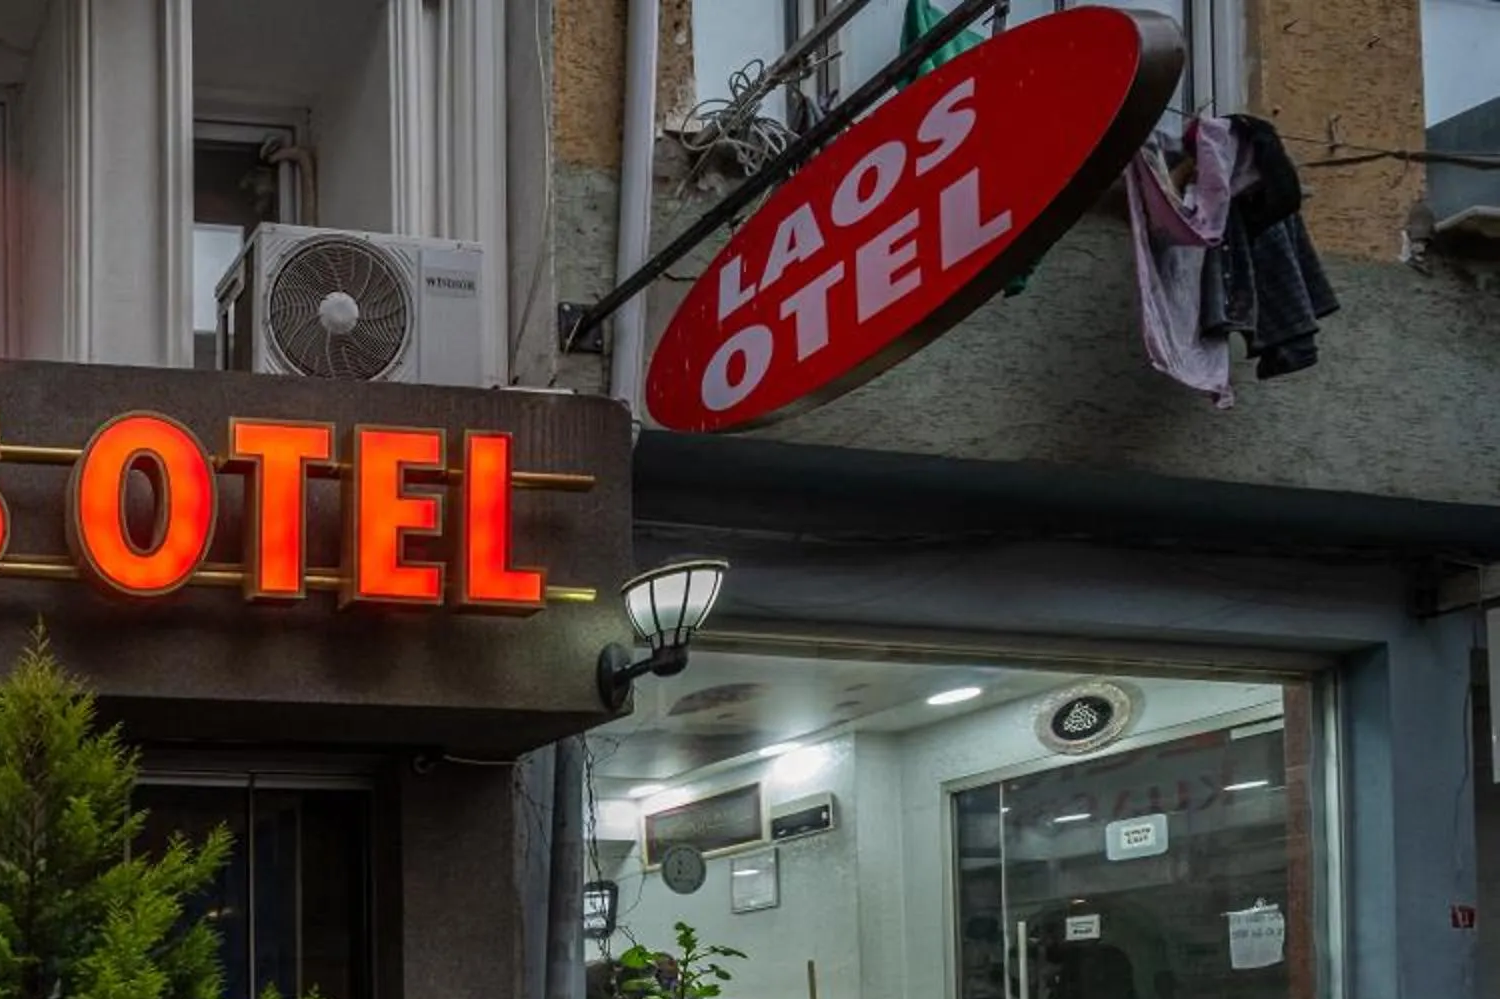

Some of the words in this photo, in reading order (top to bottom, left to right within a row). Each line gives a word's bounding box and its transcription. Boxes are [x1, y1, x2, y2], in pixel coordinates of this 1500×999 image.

[700, 166, 1013, 412] OTEL
[717, 77, 978, 323] LAOS
[67, 410, 547, 610] OTEL
